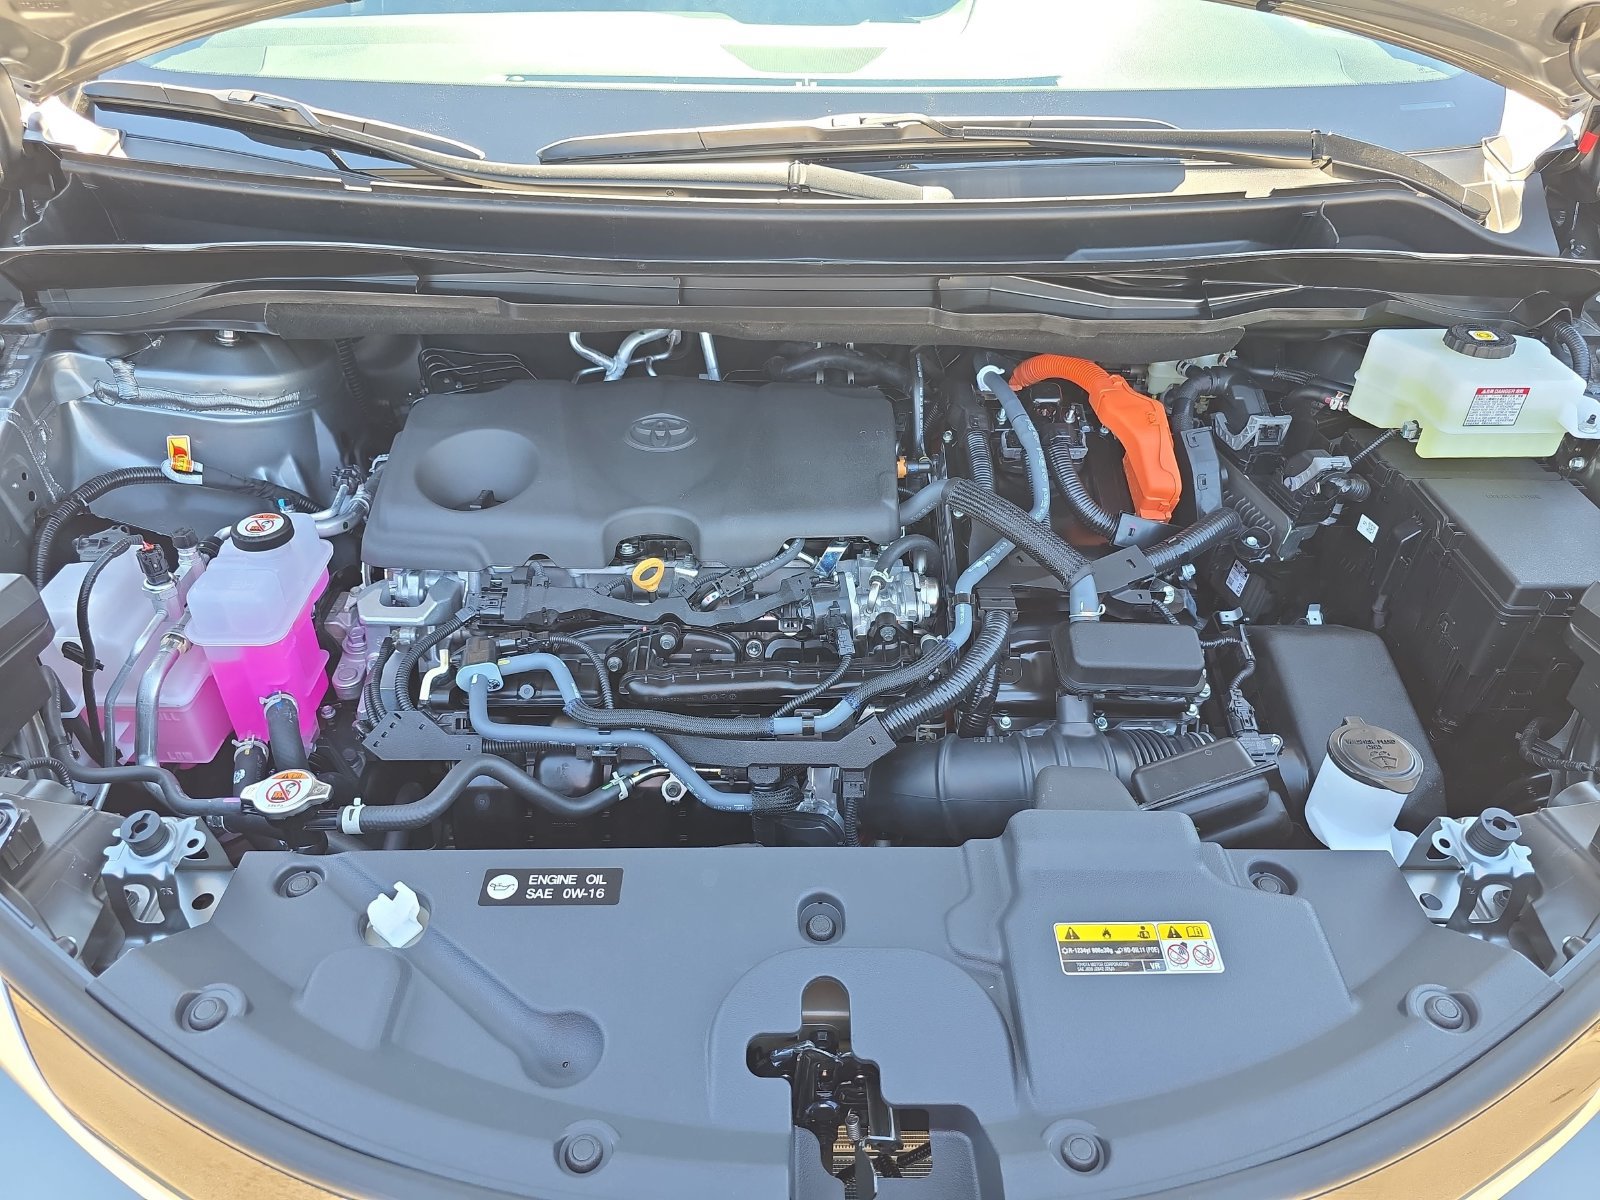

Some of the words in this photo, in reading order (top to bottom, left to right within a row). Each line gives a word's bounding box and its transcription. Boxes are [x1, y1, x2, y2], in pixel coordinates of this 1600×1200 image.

[528, 874, 578, 885] ENGINE
[586, 874, 607, 885] OIL
[526, 888, 554, 899] SAE
[563, 888, 605, 899] 0W-16
[1150, 962, 1160, 970] VR
